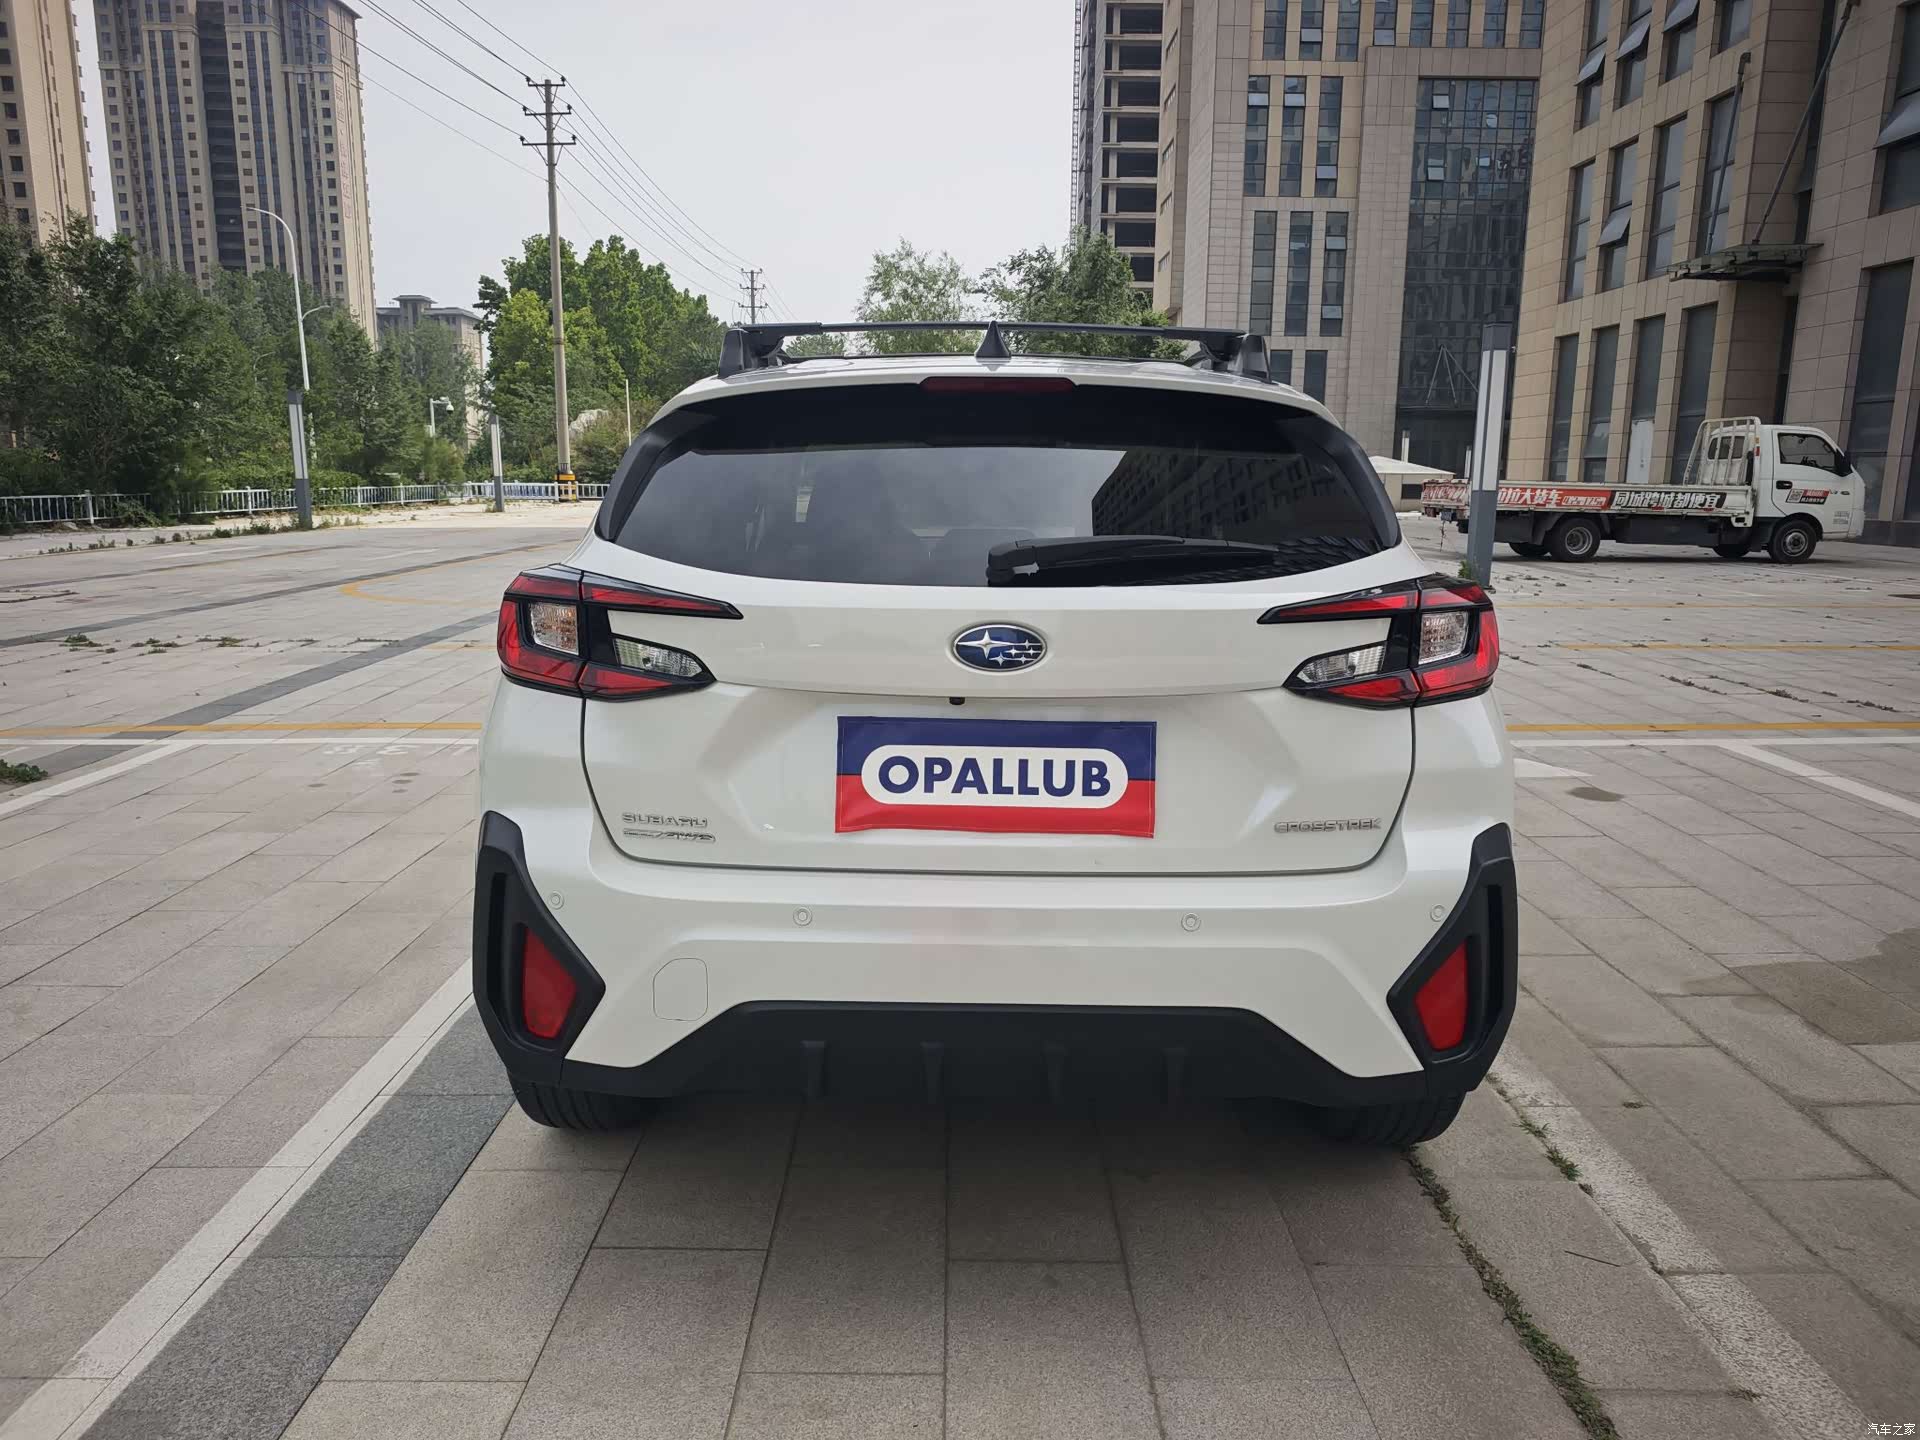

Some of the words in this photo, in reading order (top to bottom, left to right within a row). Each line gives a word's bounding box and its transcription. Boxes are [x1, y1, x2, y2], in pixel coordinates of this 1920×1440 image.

[1611, 491, 1721, 509] 同城跨城都便宜
[878, 755, 1111, 798] OPALLUB
[622, 812, 708, 828] SUBARU
[1273, 818, 1382, 834] CROSSTREK
